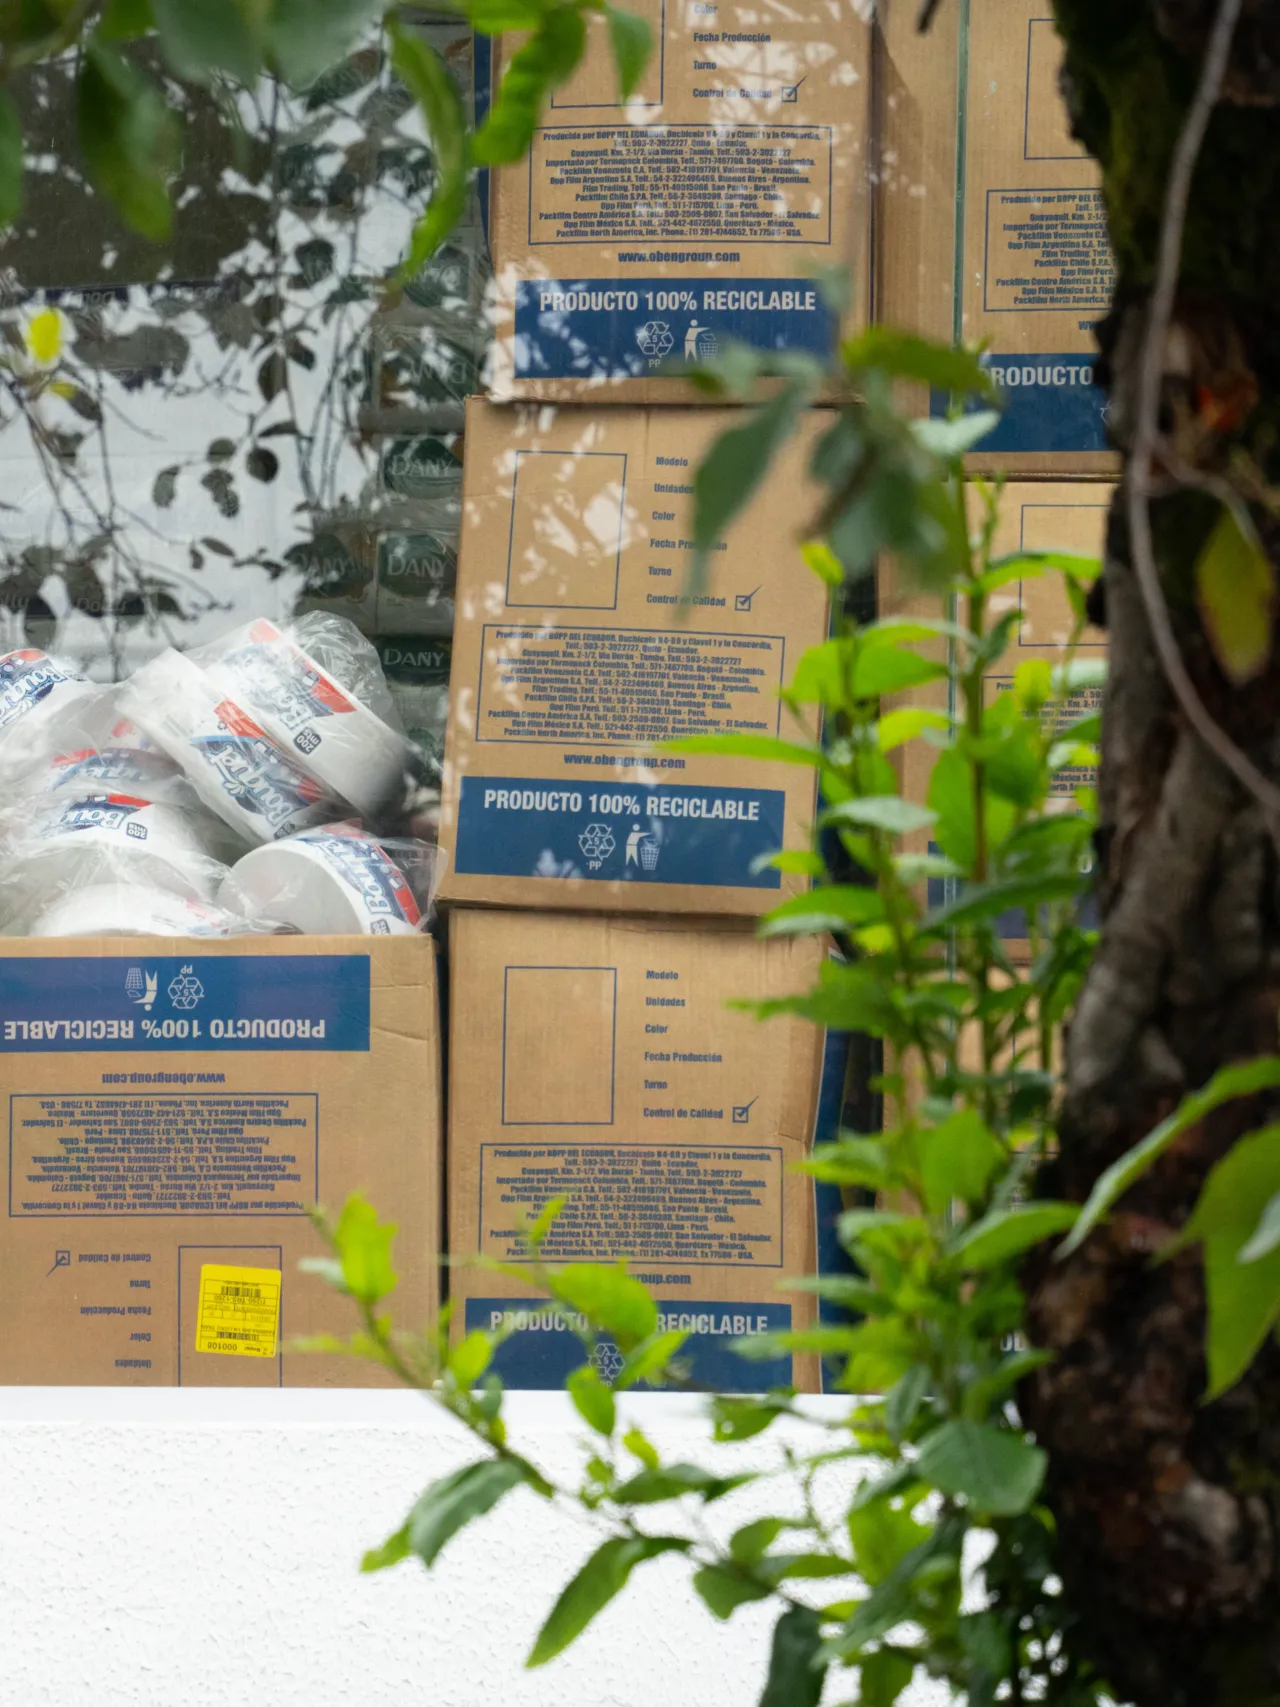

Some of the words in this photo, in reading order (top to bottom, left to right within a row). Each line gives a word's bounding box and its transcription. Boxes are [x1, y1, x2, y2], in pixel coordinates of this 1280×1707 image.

[694, 33, 719, 42] Fecha
[722, 32, 771, 42] Producción
[694, 61, 716, 70] Turno
[693, 88, 723, 98] Control
[740, 88, 772, 100] Calidad
[618, 252, 740, 262] www.obengroup.com
[540, 292, 638, 311] PRODUCTO
[645, 292, 697, 310] 100%
[704, 291, 815, 310] RECICLABLE
[656, 456, 688, 467] Modelo
[652, 511, 675, 520] Color
[650, 539, 676, 548] Fecha
[387, 554, 451, 578] DANY
[649, 566, 671, 576] Turno
[384, 648, 446, 667] DANY
[564, 755, 685, 768] www.obengroup.com
[207, 743, 294, 826] Bouquet
[484, 790, 582, 811] PRODUCTO
[589, 794, 640, 814] 100%
[646, 797, 759, 821] RECICLABLE
[646, 970, 678, 980] Modelo
[646, 997, 685, 1006] Unidades
[4, 1020, 133, 1039] RECICLABLE
[141, 1020, 201, 1038] 100%
[210, 1019, 325, 1038] PRODUCTO
[645, 1024, 668, 1033] Color
[645, 1052, 670, 1061] Fecha
[673, 1052, 722, 1062] Producción
[102, 1073, 225, 1084] www.obengroup.com
[644, 1080, 667, 1089] Turno
[644, 1108, 674, 1117] Control
[690, 1109, 723, 1118] Calidad
[79, 1254, 107, 1262] Calidad
[123, 1254, 151, 1262] Control
[130, 1280, 151, 1288] Turno
[80, 1306, 125, 1315] Producción
[127, 1306, 151, 1315] Fecha
[657, 1314, 768, 1336] RECICLABLE
[130, 1333, 151, 1342] Color
[115, 1360, 151, 1368] Unidades
